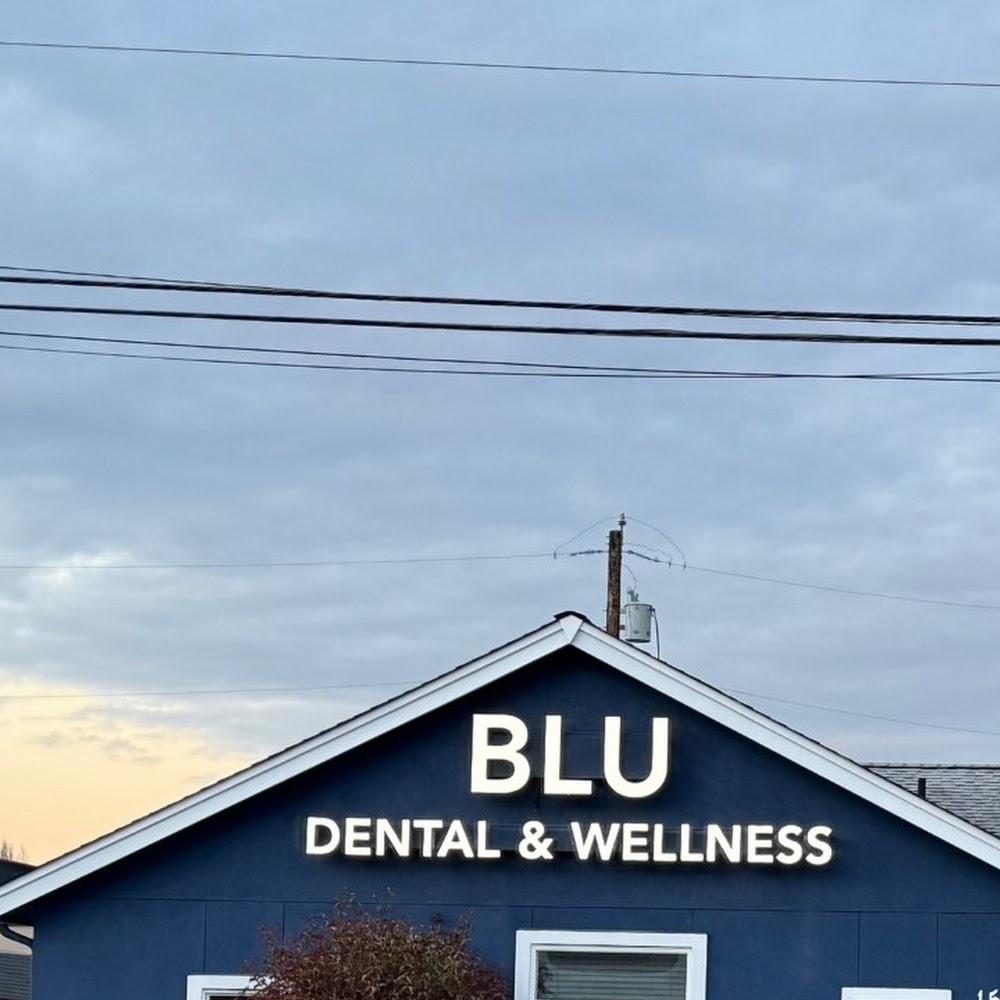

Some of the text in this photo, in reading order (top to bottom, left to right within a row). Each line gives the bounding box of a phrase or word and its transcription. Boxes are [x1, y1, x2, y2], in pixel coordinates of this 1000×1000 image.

[470, 713, 669, 798] BLU
[305, 816, 833, 866] DENTAL & WELLNESS
